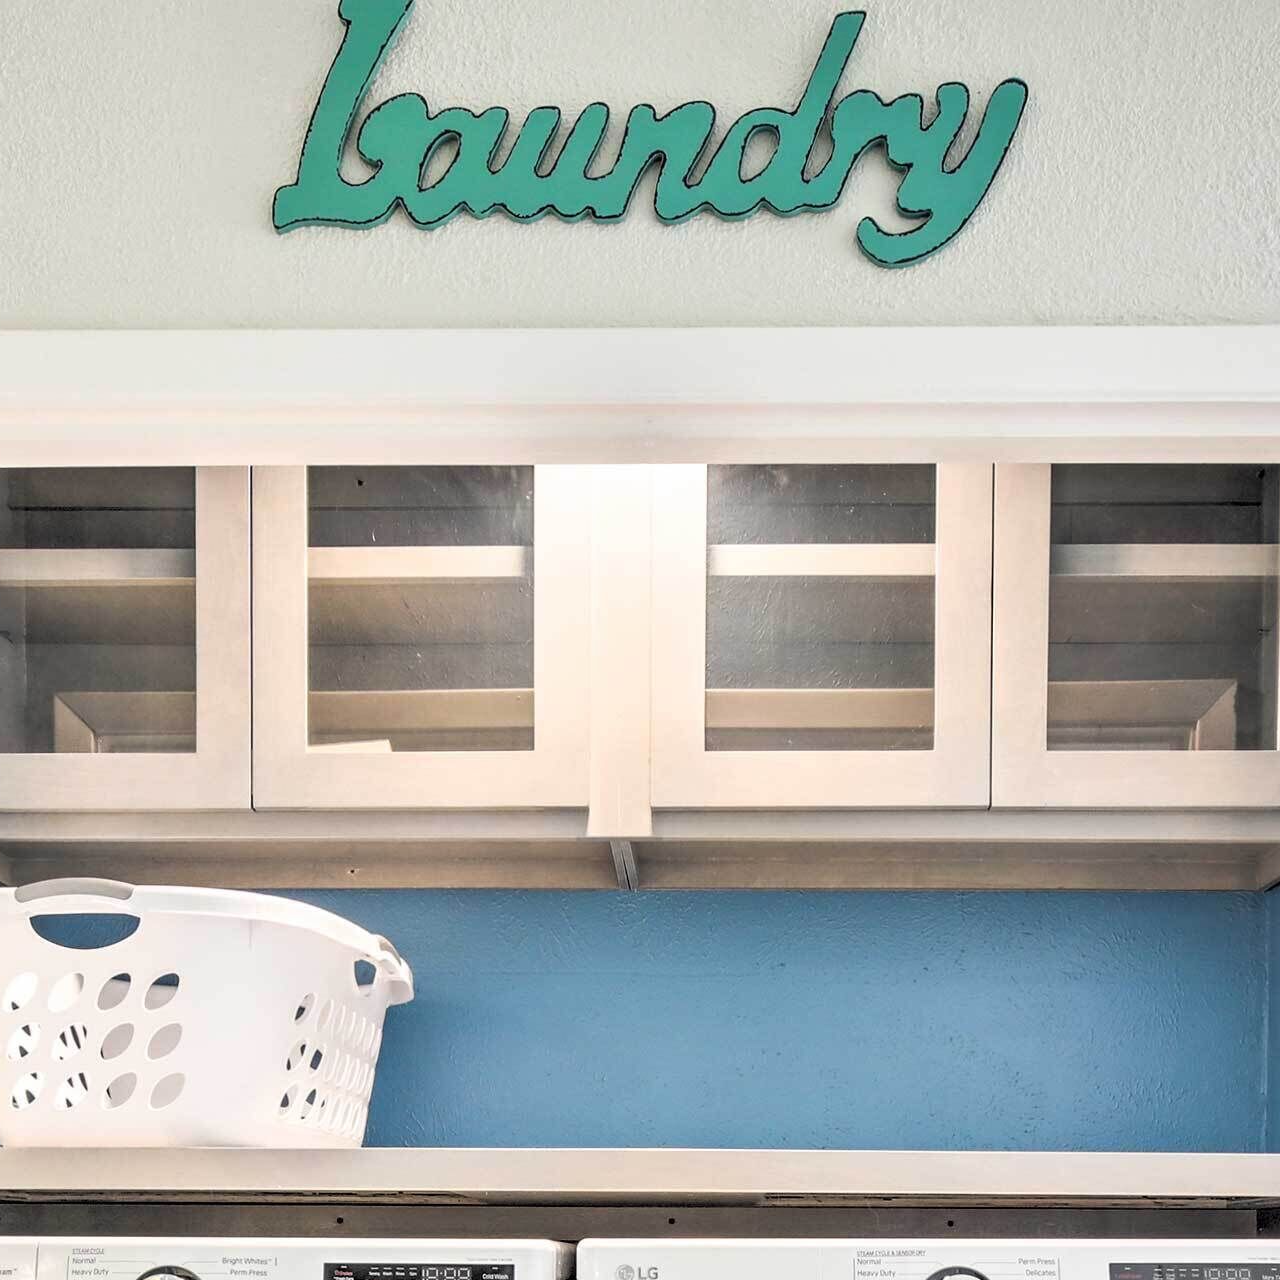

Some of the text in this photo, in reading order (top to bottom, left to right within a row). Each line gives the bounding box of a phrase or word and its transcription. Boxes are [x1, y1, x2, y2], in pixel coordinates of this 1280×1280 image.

[273, 0, 1027, 268] Laundry
[222, 1257, 243, 1265] Bright
[93, 1268, 109, 1276] Duty
[638, 1267, 659, 1280] LG
[880, 1269, 896, 1277] Duty
